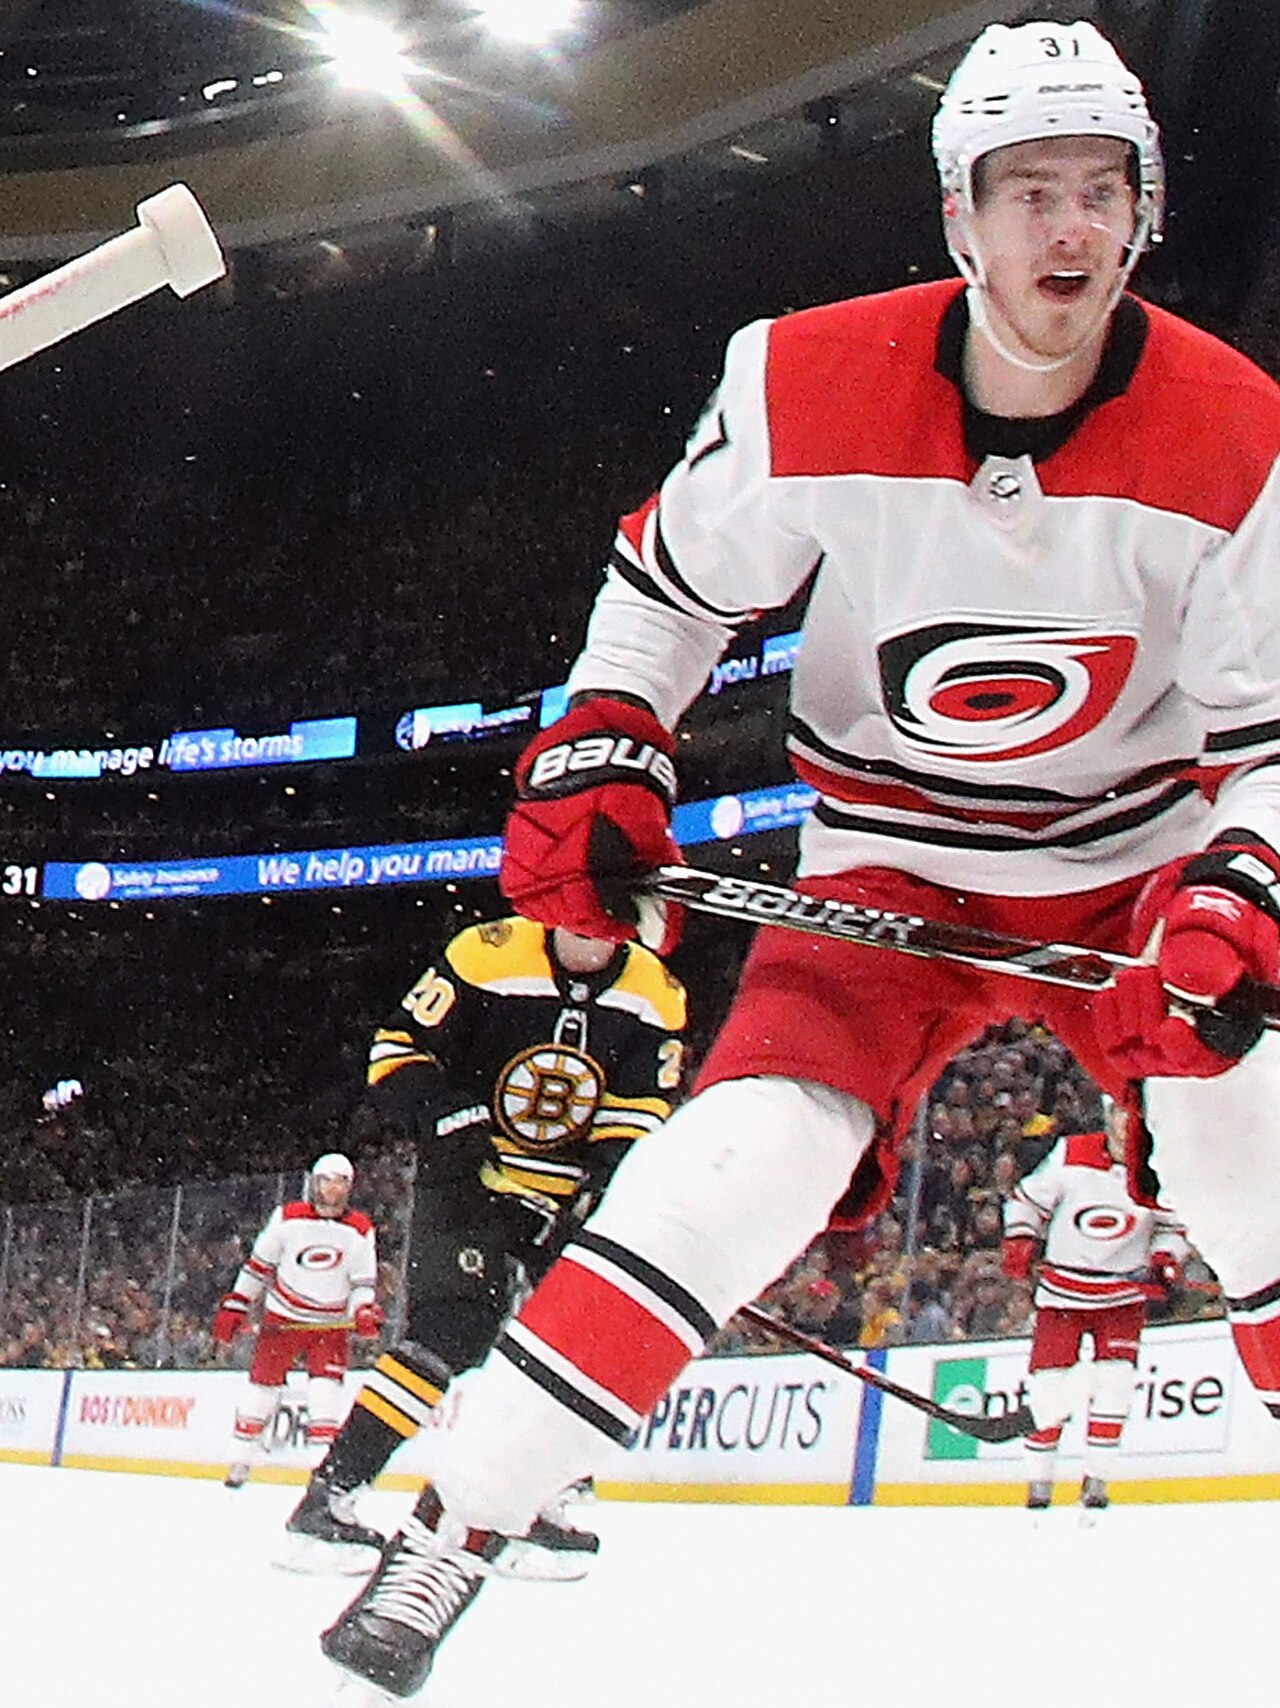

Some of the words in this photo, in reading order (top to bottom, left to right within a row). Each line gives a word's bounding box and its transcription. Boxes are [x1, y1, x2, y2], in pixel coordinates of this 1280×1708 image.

[709, 655, 757, 695] you
[52, 748, 154, 775] manage
[157, 738, 217, 765] life's
[219, 733, 304, 763] storms
[528, 737, 678, 796] BAUE
[2, 866, 37, 896] 31
[257, 857, 300, 886] We
[305, 851, 364, 885] help
[367, 849, 422, 885] you
[426, 846, 503, 873] mana
[702, 876, 925, 945] BAUER
[626, 1381, 827, 1450] PERCUTS
